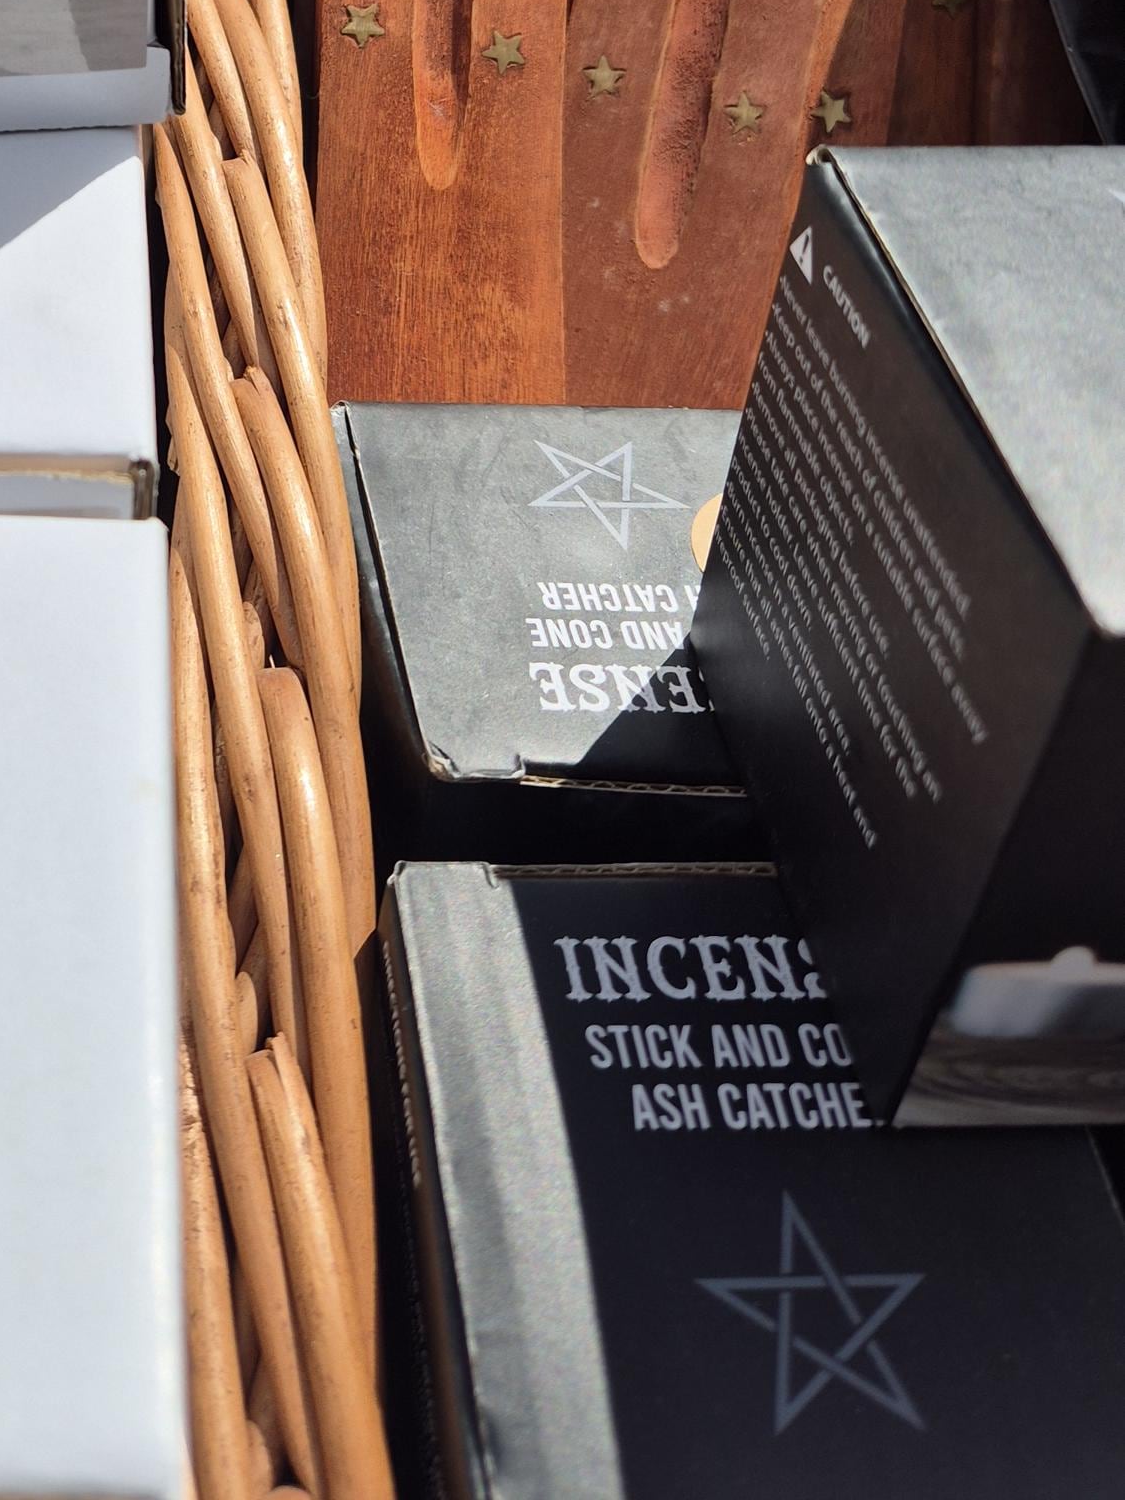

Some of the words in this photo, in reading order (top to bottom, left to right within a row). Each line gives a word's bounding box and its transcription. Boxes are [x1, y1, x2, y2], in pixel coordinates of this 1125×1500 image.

[822, 265, 869, 348] CAUTION
[757, 351, 776, 394] from
[776, 388, 820, 477] flammable
[819, 475, 852, 545] objects.
[794, 345, 811, 376] out
[810, 373, 823, 394] of
[820, 389, 837, 423] the
[836, 420, 862, 472] reach
[862, 469, 876, 492] of
[873, 489, 914, 568] children
[913, 567, 939, 608] and
[805, 318, 829, 368] leave
[828, 360, 866, 437] burning
[865, 427, 903, 501] incense
[537, 581, 679, 613] CATCHER
[715, 518, 745, 595] fireproof
[742, 594, 769, 660] surface.
[730, 455, 760, 519] product
[760, 515, 769, 537] to
[769, 537, 789, 576] cool
[786, 574, 811, 631] down.
[738, 427, 766, 490] incense
[765, 485, 792, 548] holder.
[793, 543, 817, 598] Leave
[817, 597, 858, 682] sufficient
[857, 678, 880, 726] time
[879, 724, 896, 758] for
[895, 757, 915, 796] the
[770, 457, 788, 496] take
[788, 495, 806, 533] care
[806, 531, 830, 584] when
[830, 582, 867, 657] moving
[865, 653, 878, 676] or
[784, 447, 796, 470] all
[794, 468, 839, 560] packaging
[838, 551, 869, 617] before
[868, 615, 887, 660] use.
[793, 385, 818, 431] place
[817, 426, 852, 496] incense
[851, 493, 865, 522] on
[865, 521, 873, 536] a
[873, 533, 912, 610] suitable
[912, 608, 952, 683] surface
[525, 617, 613, 649] CONE
[528, 661, 715, 714] ENSE
[620, 620, 684, 650] AND
[744, 520, 774, 585] incense
[772, 581, 781, 604] in
[781, 603, 788, 618] a
[788, 615, 830, 707] ventilated
[828, 706, 848, 755] area.
[745, 559, 761, 598] that
[760, 596, 772, 619] all
[770, 618, 792, 669] ashes
[791, 664, 807, 697] fall
[805, 697, 827, 743] onto
[825, 744, 833, 759] a
[832, 754, 855, 805] heat
[853, 806, 876, 847] and
[585, 1023, 703, 1069] STICK
[711, 1023, 791, 1069] AND
[631, 1083, 711, 1131] ASH
[717, 1082, 885, 1130] CATCHE
